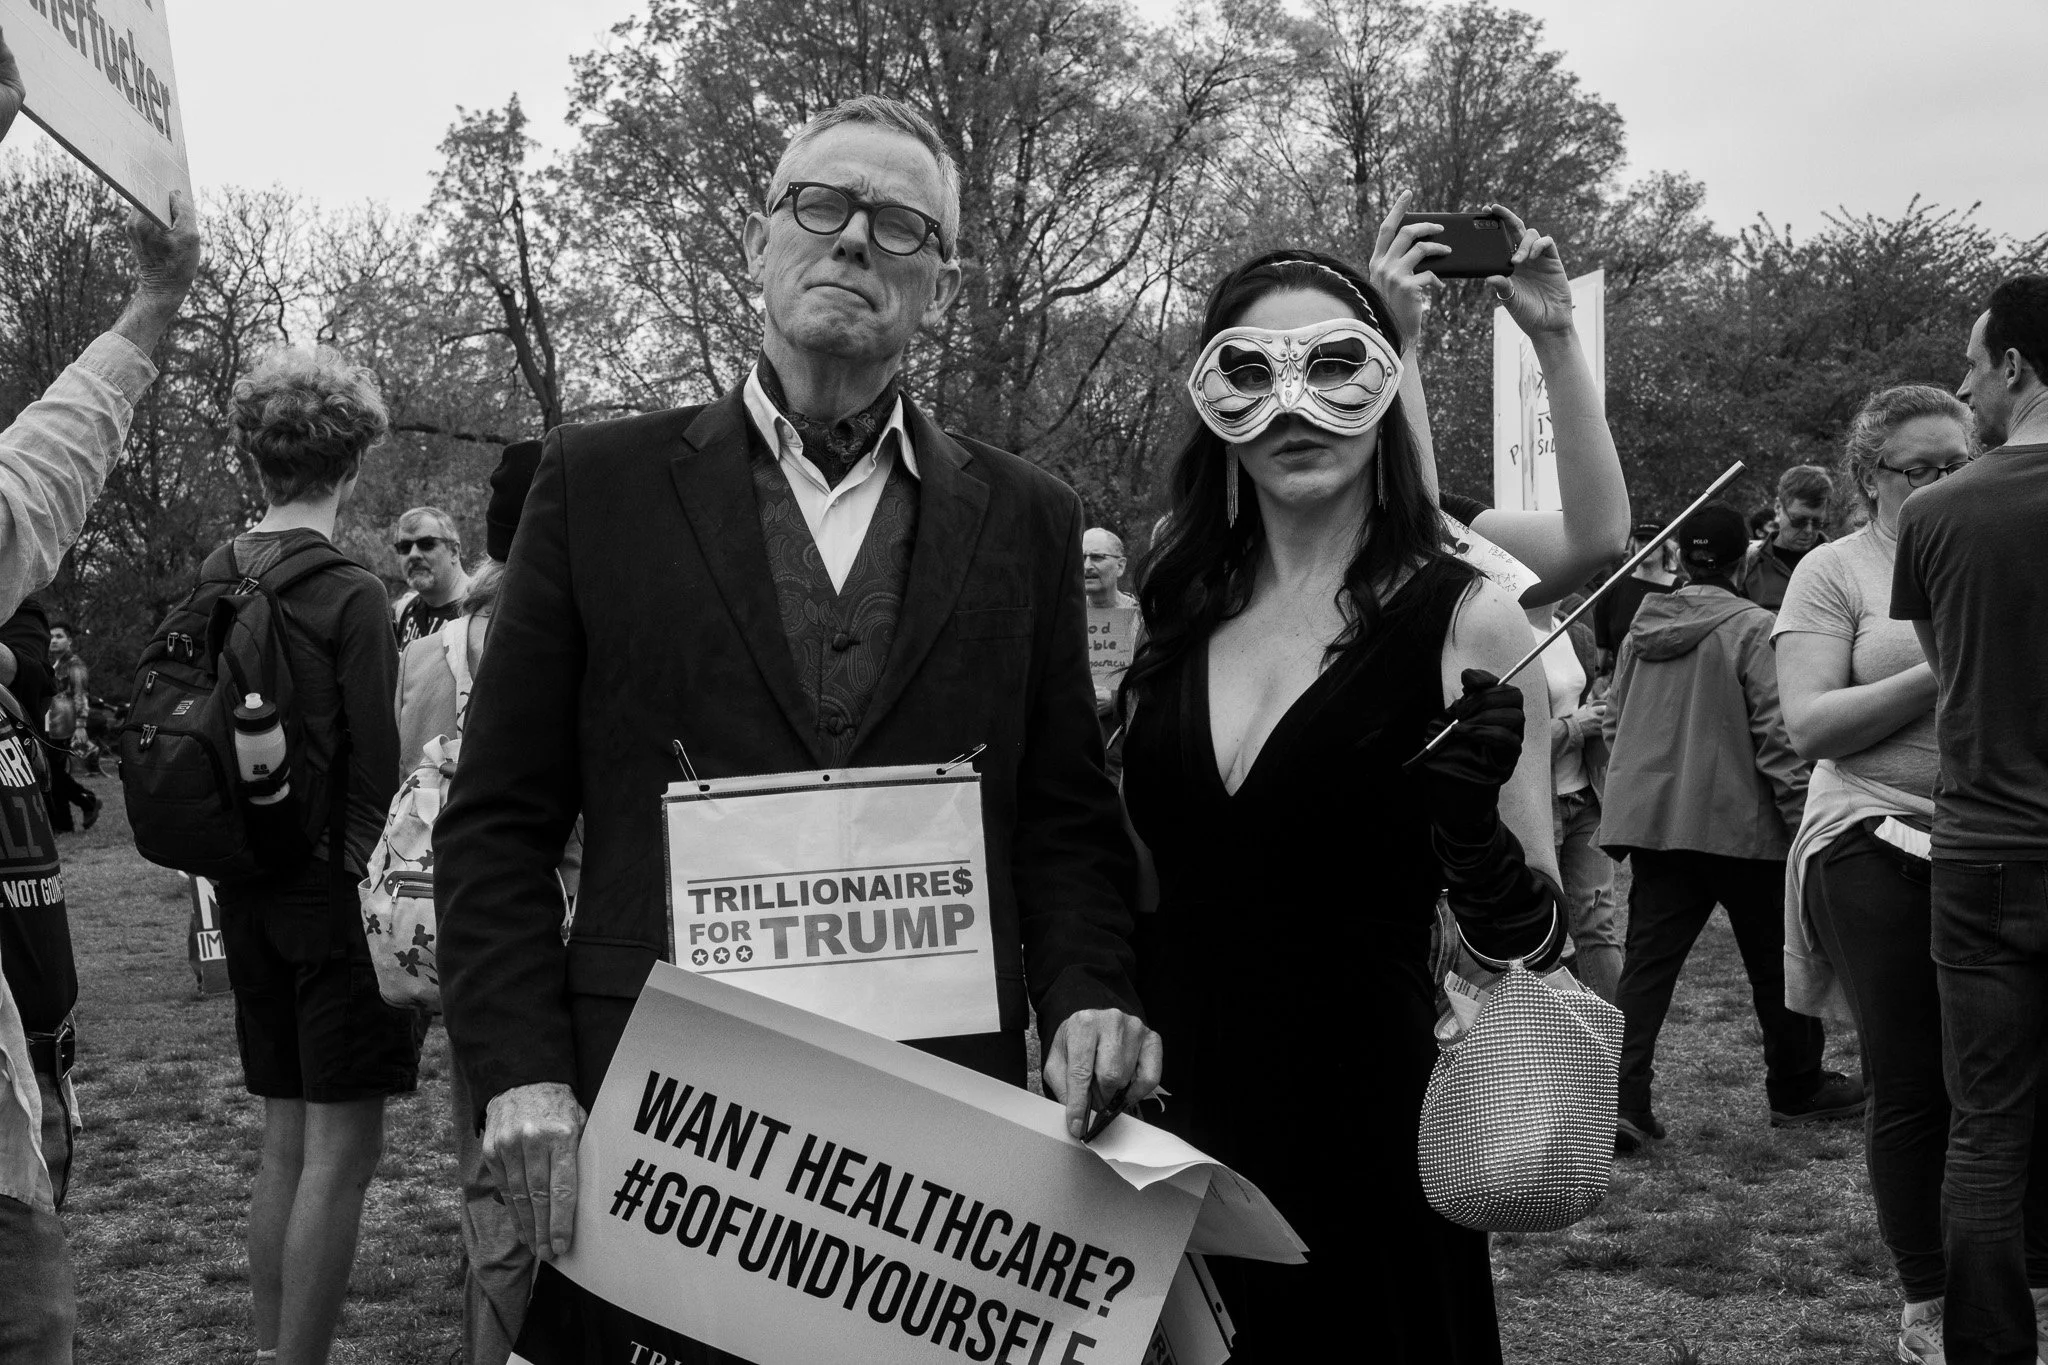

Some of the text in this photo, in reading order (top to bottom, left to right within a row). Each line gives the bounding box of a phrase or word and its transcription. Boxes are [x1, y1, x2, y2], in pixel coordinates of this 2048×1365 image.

[2, 879, 39, 908] NOT
[687, 866, 974, 915] TRILLIONAIRE$
[689, 903, 975, 960] FOR TRUMP
[632, 1071, 1136, 1318] WANT HEALTHCARE?
